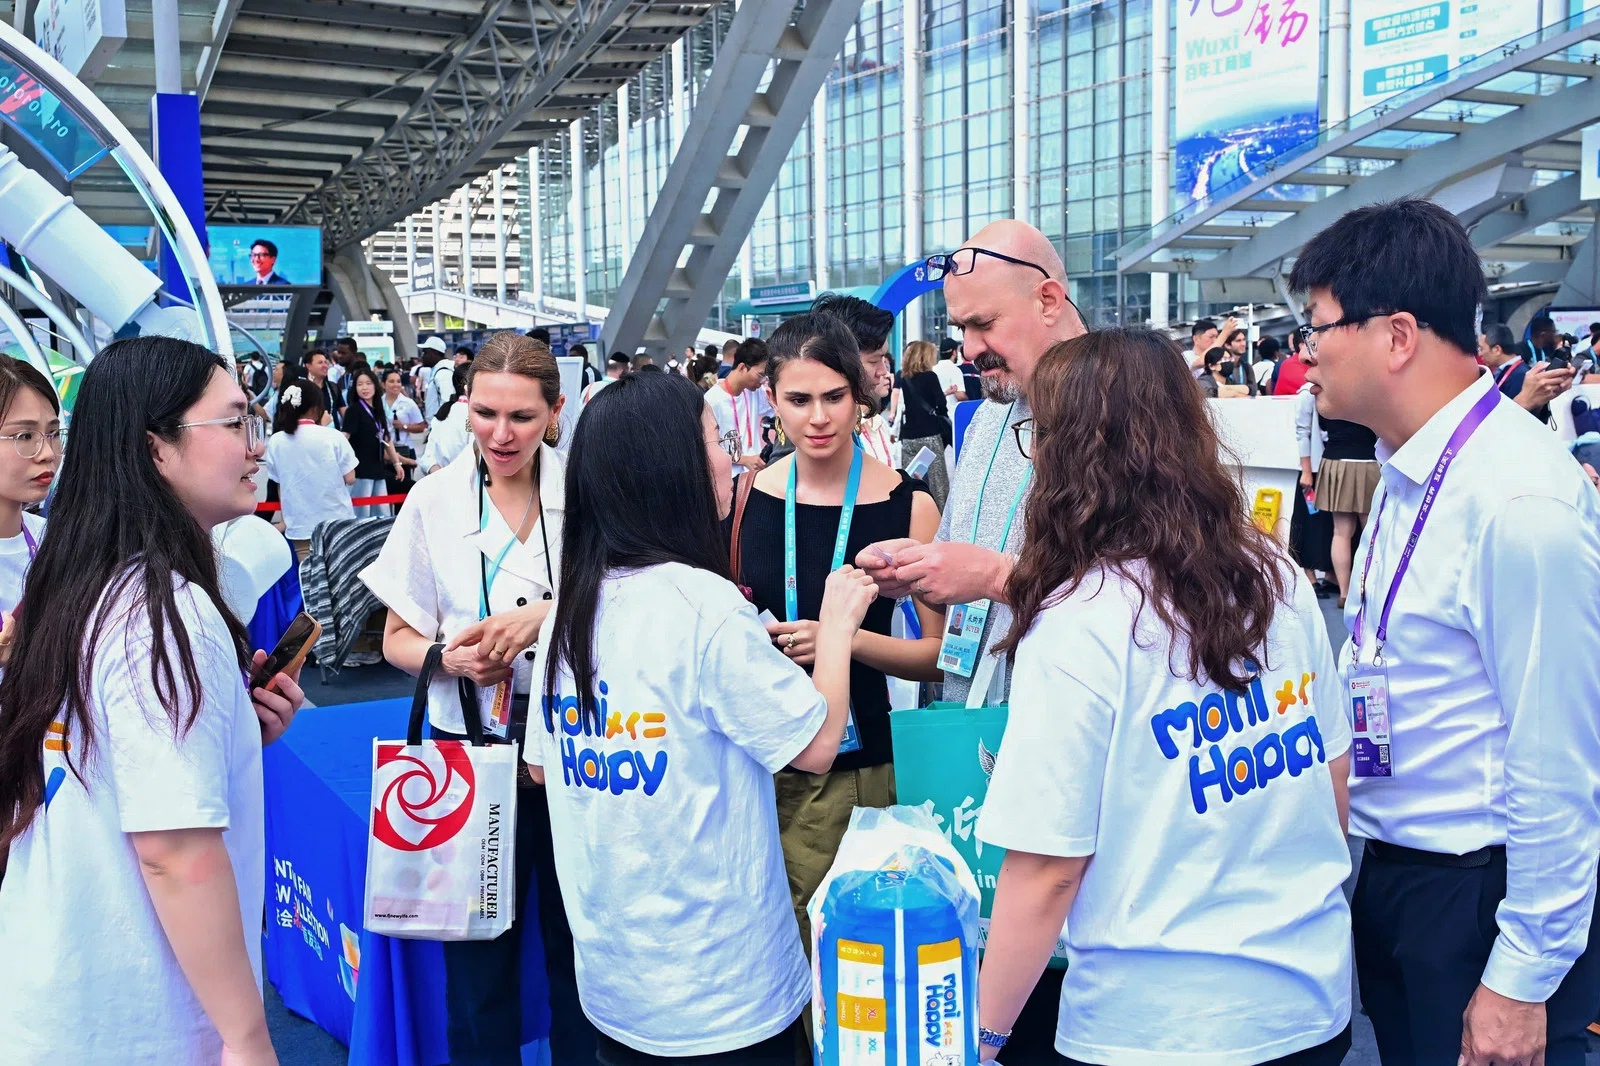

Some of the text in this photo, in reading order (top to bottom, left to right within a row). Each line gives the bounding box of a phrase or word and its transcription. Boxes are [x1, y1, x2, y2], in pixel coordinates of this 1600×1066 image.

[1186, 28, 1239, 60] Wuxi
[1419, 447, 1453, 520] 广交世界 互利天下
[560, 737, 668, 796] Happy
[487, 803, 500, 919] MANUFACTURER
[867, 978, 876, 986] L
[867, 1007, 878, 1020] XL
[925, 985, 943, 1047] Happy
[868, 1037, 877, 1055] XXL
